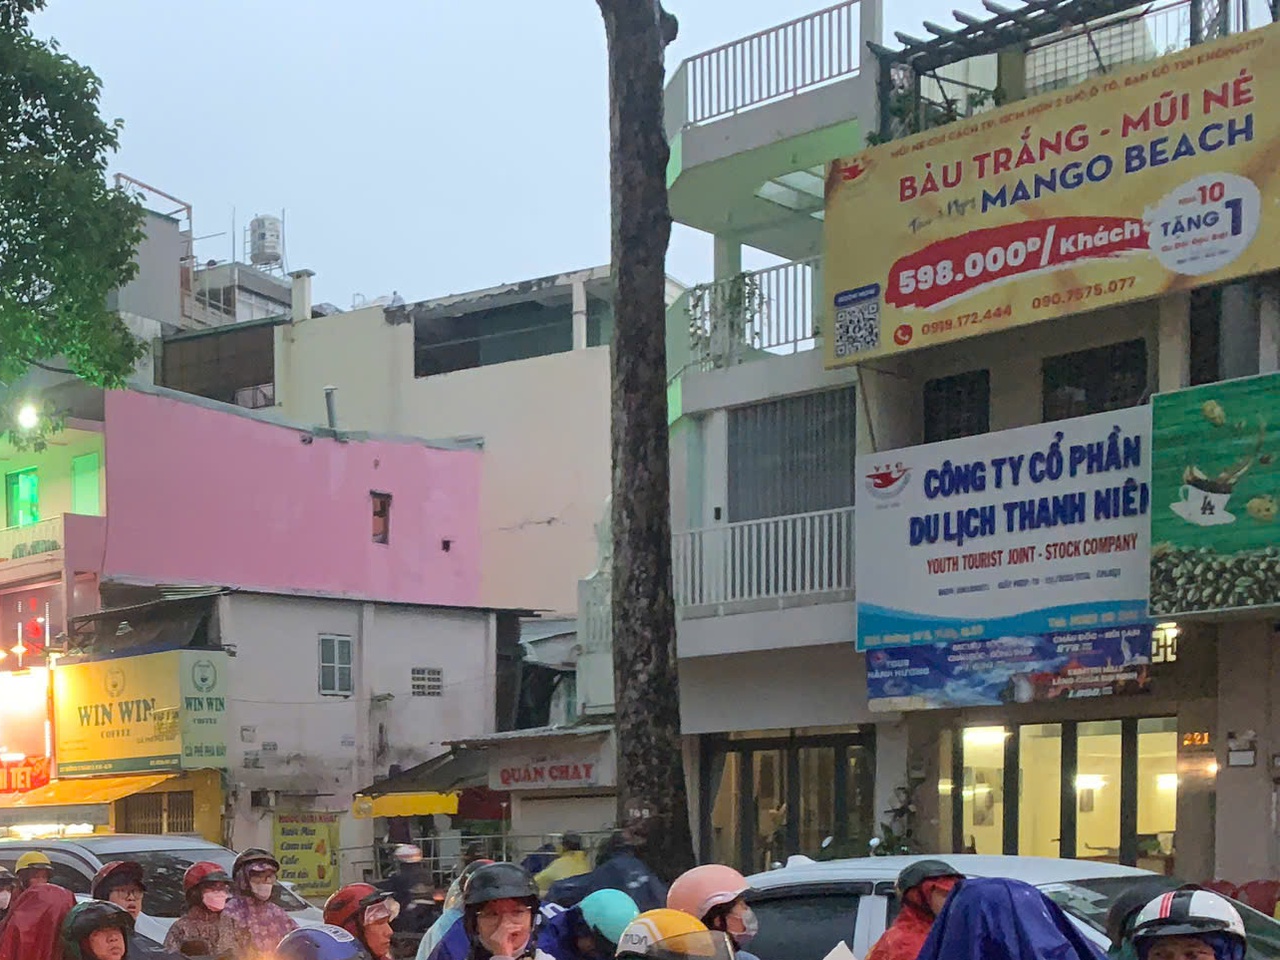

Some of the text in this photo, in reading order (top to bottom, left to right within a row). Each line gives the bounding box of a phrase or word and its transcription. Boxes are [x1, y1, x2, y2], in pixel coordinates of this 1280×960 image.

[973, 126, 1089, 180] TRẮNG
[1121, 90, 1190, 138] MŨI
[1203, 68, 1254, 115] NÉ
[981, 113, 1254, 213] MANGO BEACH
[1197, 182, 1225, 206] 10
[1161, 198, 1244, 239] TẶNG 1
[1060, 221, 1141, 256] Khách
[924, 460, 986, 499] CÔNG
[991, 455, 1024, 488] TY
[1029, 430, 1064, 483] CỔ
[909, 511, 939, 546] DU
[944, 504, 995, 546] LỊCH
[1003, 492, 1086, 532] THANH
[927, 557, 958, 575] YOUTH
[962, 550, 1002, 571] TOURIST
[1007, 545, 1036, 566] JOINT
[1045, 540, 1081, 561] STOCK
[1083, 532, 1138, 556] COMPANY
[78, 702, 113, 727] WIN
[118, 697, 156, 723] WIN
[184, 696, 225, 712] WIN WIN
[100, 728, 131, 739] COFFEE
[548, 764, 594, 781] CHAY
